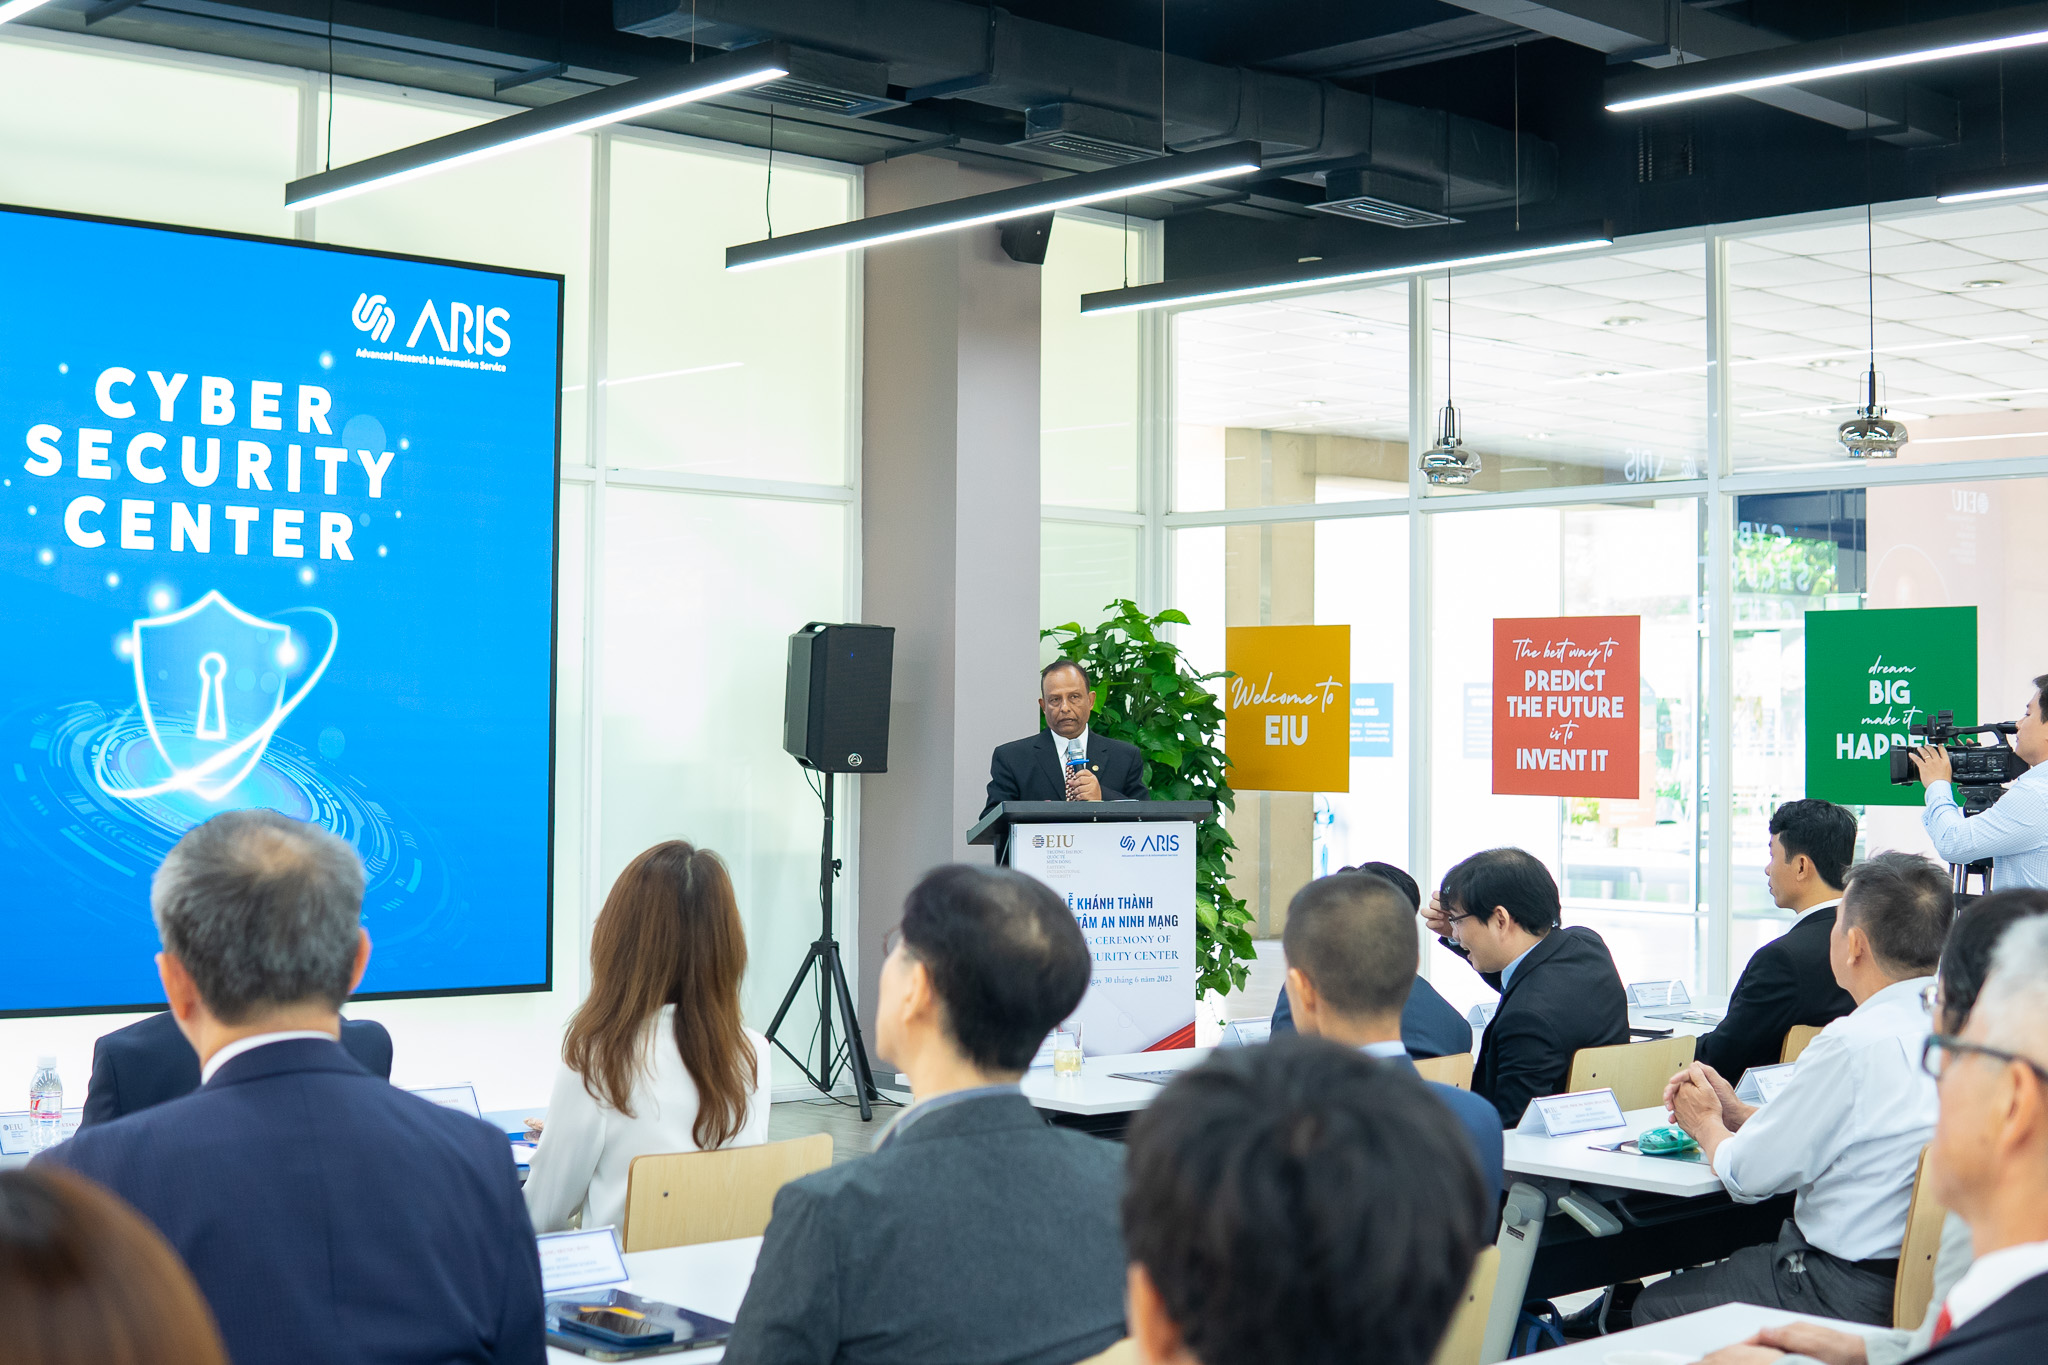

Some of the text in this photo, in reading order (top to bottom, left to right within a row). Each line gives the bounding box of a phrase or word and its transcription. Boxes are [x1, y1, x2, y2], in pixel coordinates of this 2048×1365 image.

[406, 299, 511, 357] ARIS
[356, 348, 506, 372] Advanced Research & Information Service
[95, 367, 333, 435] CYBER
[24, 424, 395, 499] SECURITY
[64, 496, 354, 561] CENTER
[1512, 637, 1619, 668] The best way to
[1868, 655, 1916, 675] dream
[1231, 671, 1343, 713] Welcome to
[1525, 669, 1606, 692] PREDICT
[1869, 679, 1911, 705] BIG
[1506, 695, 1625, 718] THE FUTURE
[1861, 705, 1924, 730] make it
[1265, 715, 1308, 746] EIU
[1549, 720, 1580, 745] is to
[1516, 748, 1609, 772] INVENT IT
[1046, 834, 1075, 848] EIU
[1140, 834, 1180, 851] ARIS
[1077, 894, 1114, 910] KHÁNH
[1118, 893, 1154, 910] THÀNH
[1076, 913, 1179, 930] TÂM AN NINH MẠNG
[1095, 935, 1154, 945] CEREMONY
[1157, 935, 1171, 943] OF
[1134, 950, 1179, 961] CENTER
[1105, 976, 1113, 984] 30
[1156, 975, 1172, 983] 2023
